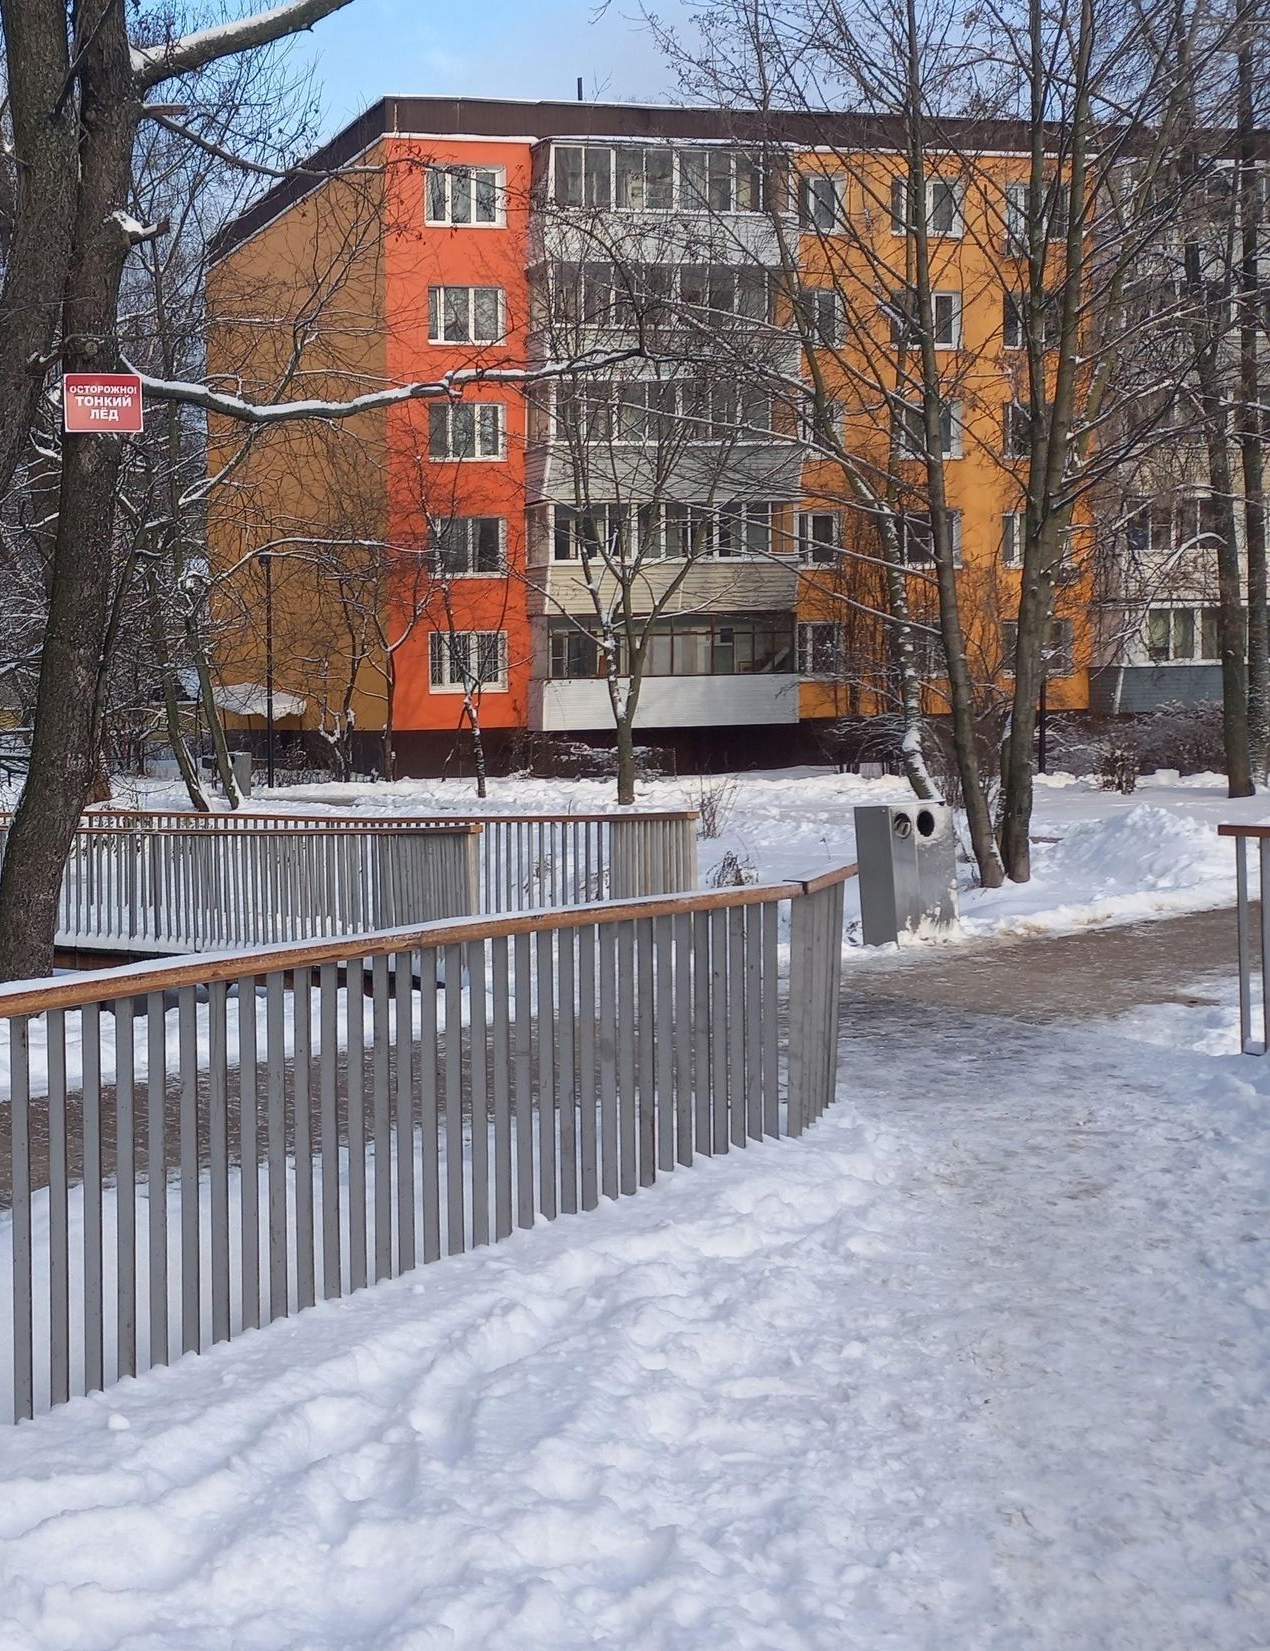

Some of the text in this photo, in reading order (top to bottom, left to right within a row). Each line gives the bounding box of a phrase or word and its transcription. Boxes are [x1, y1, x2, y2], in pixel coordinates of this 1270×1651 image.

[69, 385, 137, 394] ОСТОРОЖНО!
[75, 395, 132, 407] ТОНКИЙ
[90, 407, 119, 421] ЛЁД
